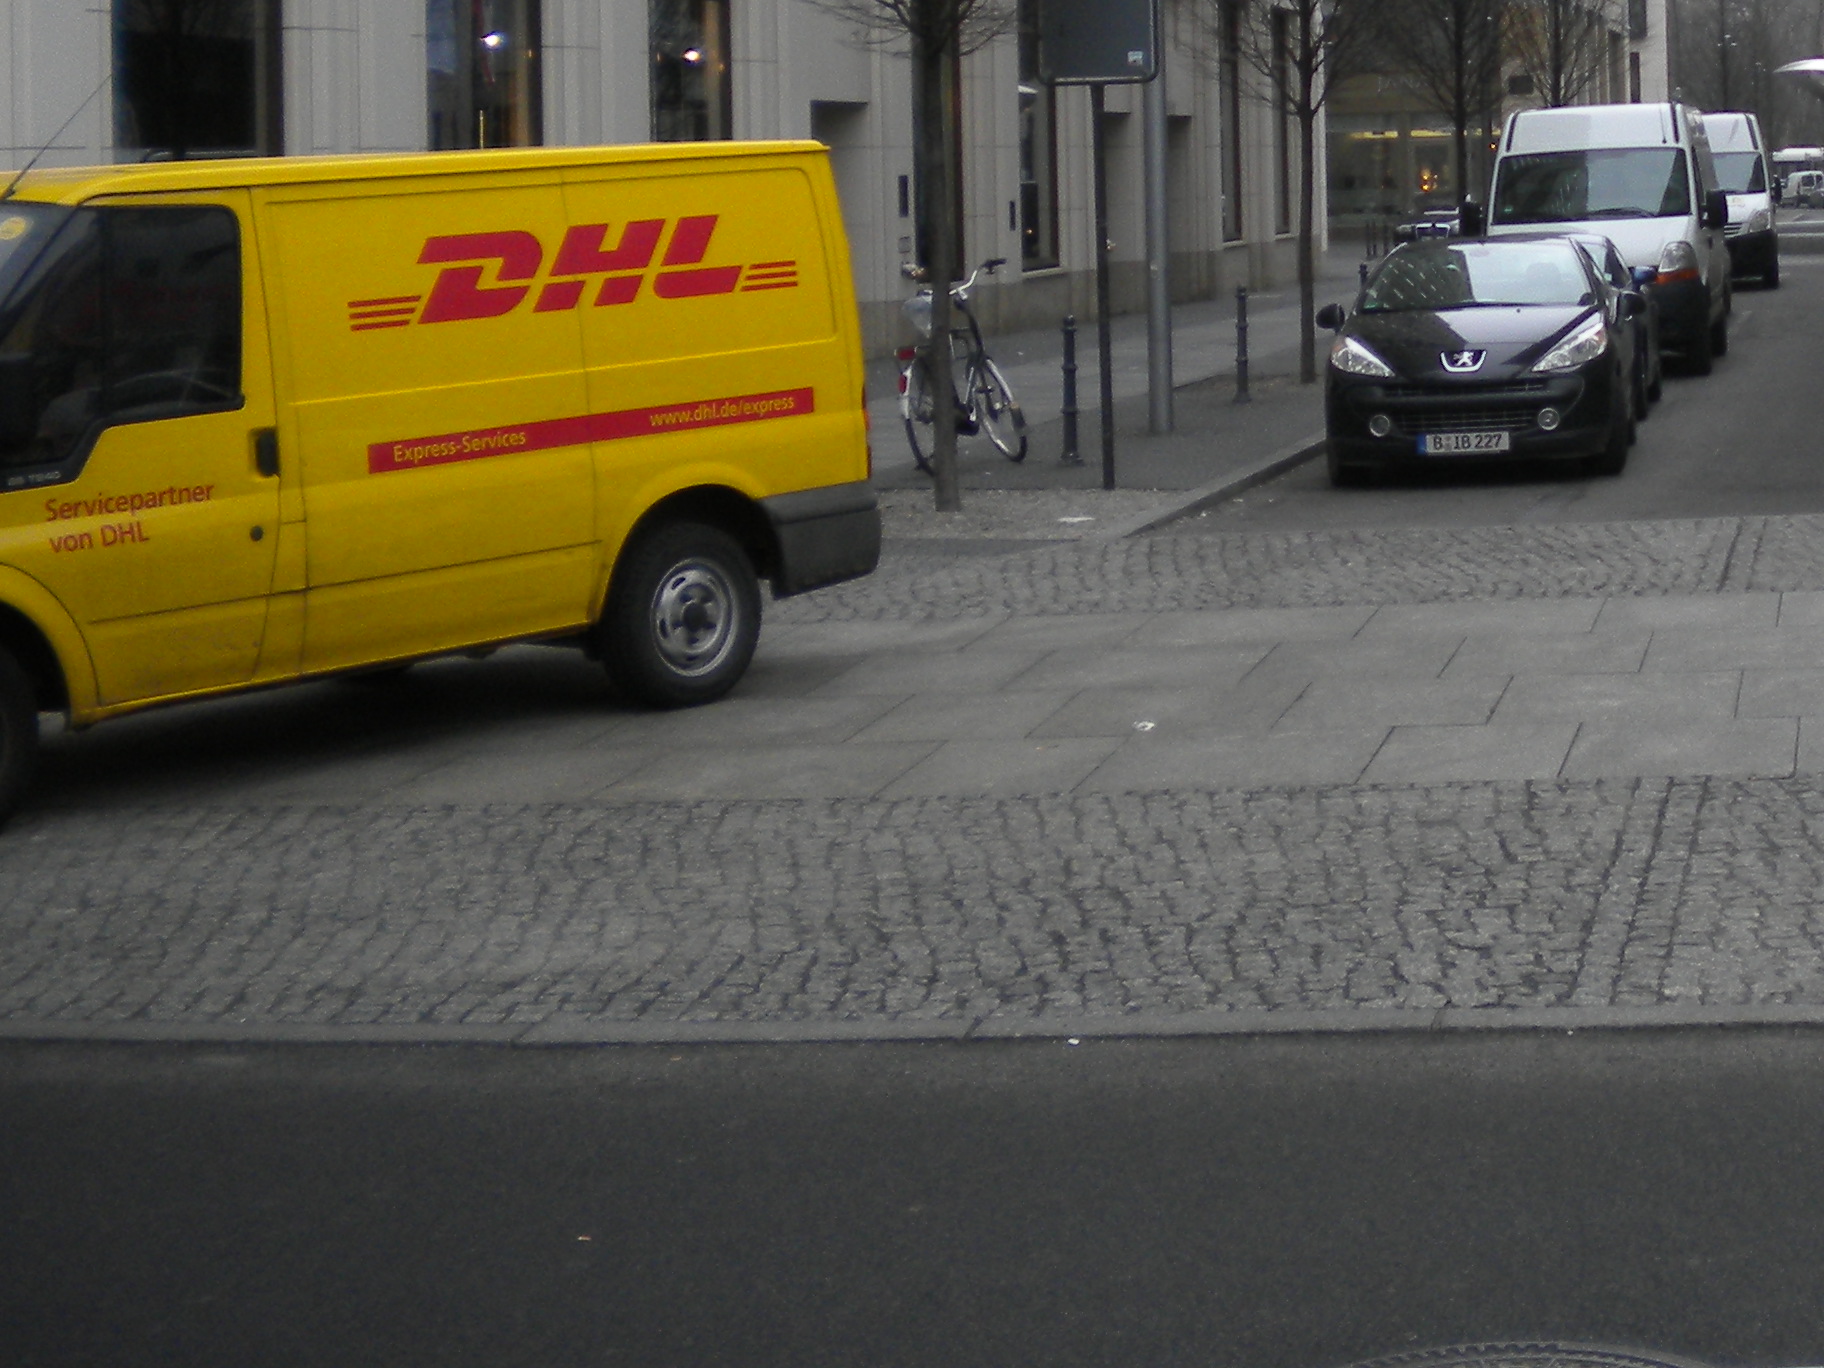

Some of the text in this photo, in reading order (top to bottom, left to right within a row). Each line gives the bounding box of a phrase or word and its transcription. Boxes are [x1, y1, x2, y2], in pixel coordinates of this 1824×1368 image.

[416, 214, 743, 324] DHL
[649, 394, 795, 427] www.dhl.de/express
[393, 431, 527, 467] Express-Services
[1433, 436, 1443, 450] B
[1475, 434, 1502, 448] 227
[45, 484, 214, 522] Servicepartner
[50, 521, 149, 554] von DHL
